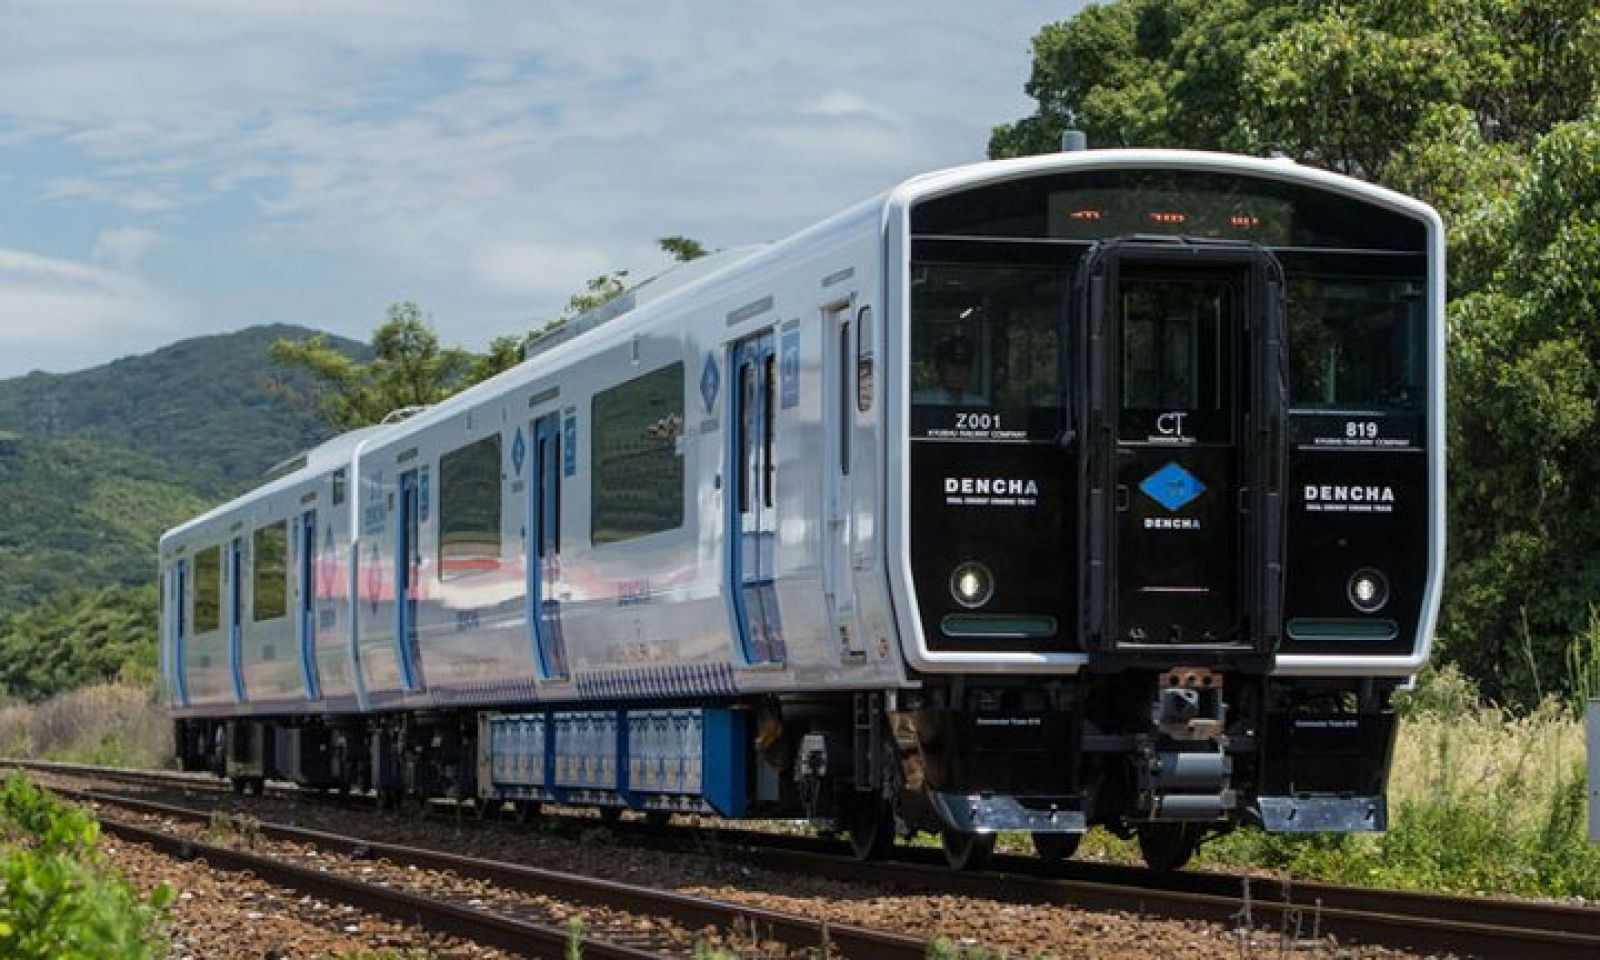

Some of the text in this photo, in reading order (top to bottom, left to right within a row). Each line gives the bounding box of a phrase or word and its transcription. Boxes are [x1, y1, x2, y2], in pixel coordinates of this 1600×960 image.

[955, 413, 1001, 429] Z001
[1157, 411, 1188, 436] CT
[1346, 421, 1378, 438] 819
[944, 477, 1039, 494] DENCHA
[1304, 485, 1395, 501] DENCHA
[1143, 517, 1201, 529] DENCHA
